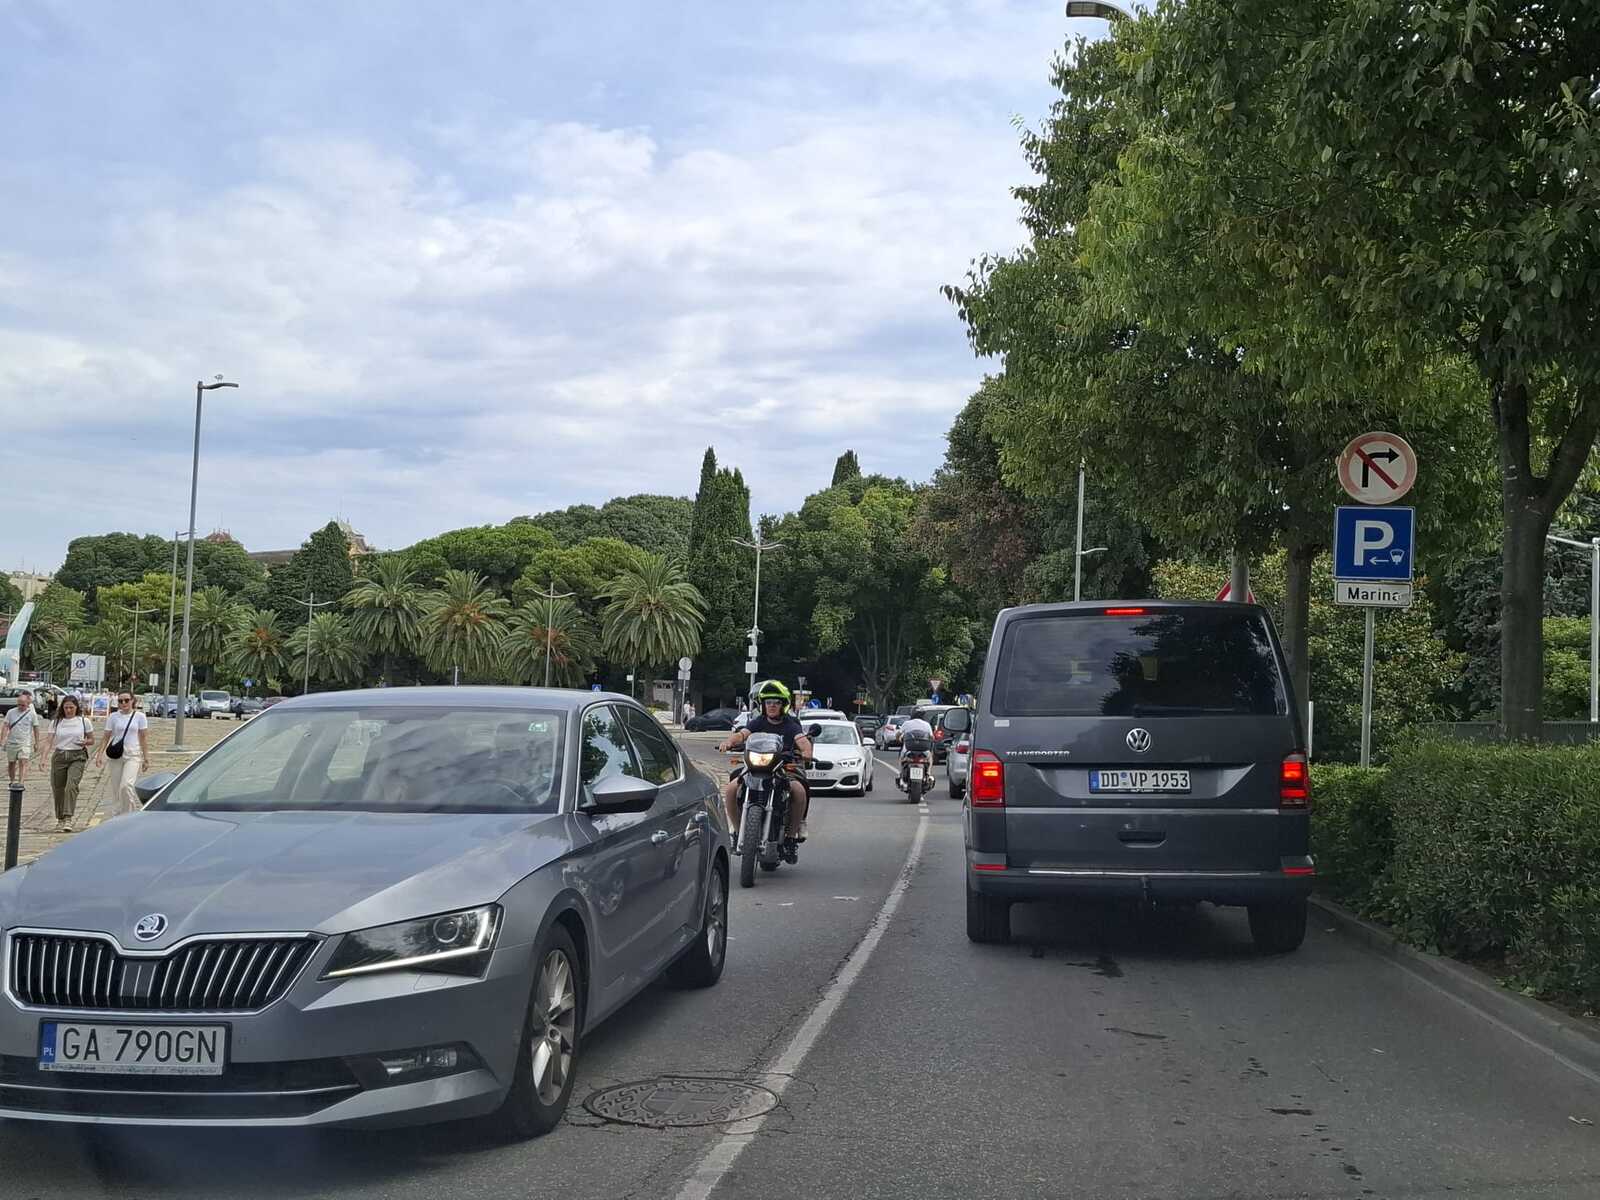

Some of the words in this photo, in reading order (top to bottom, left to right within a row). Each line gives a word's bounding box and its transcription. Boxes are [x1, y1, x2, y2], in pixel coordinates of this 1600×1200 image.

[1354, 520, 1394, 566] P
[1100, 772, 1119, 787] DD
[1129, 772, 1148, 787] VP
[1151, 772, 1188, 787] 1953
[43, 1047, 54, 1056] PL
[63, 1027, 100, 1061] GA
[115, 1029, 217, 1063] 790GN
